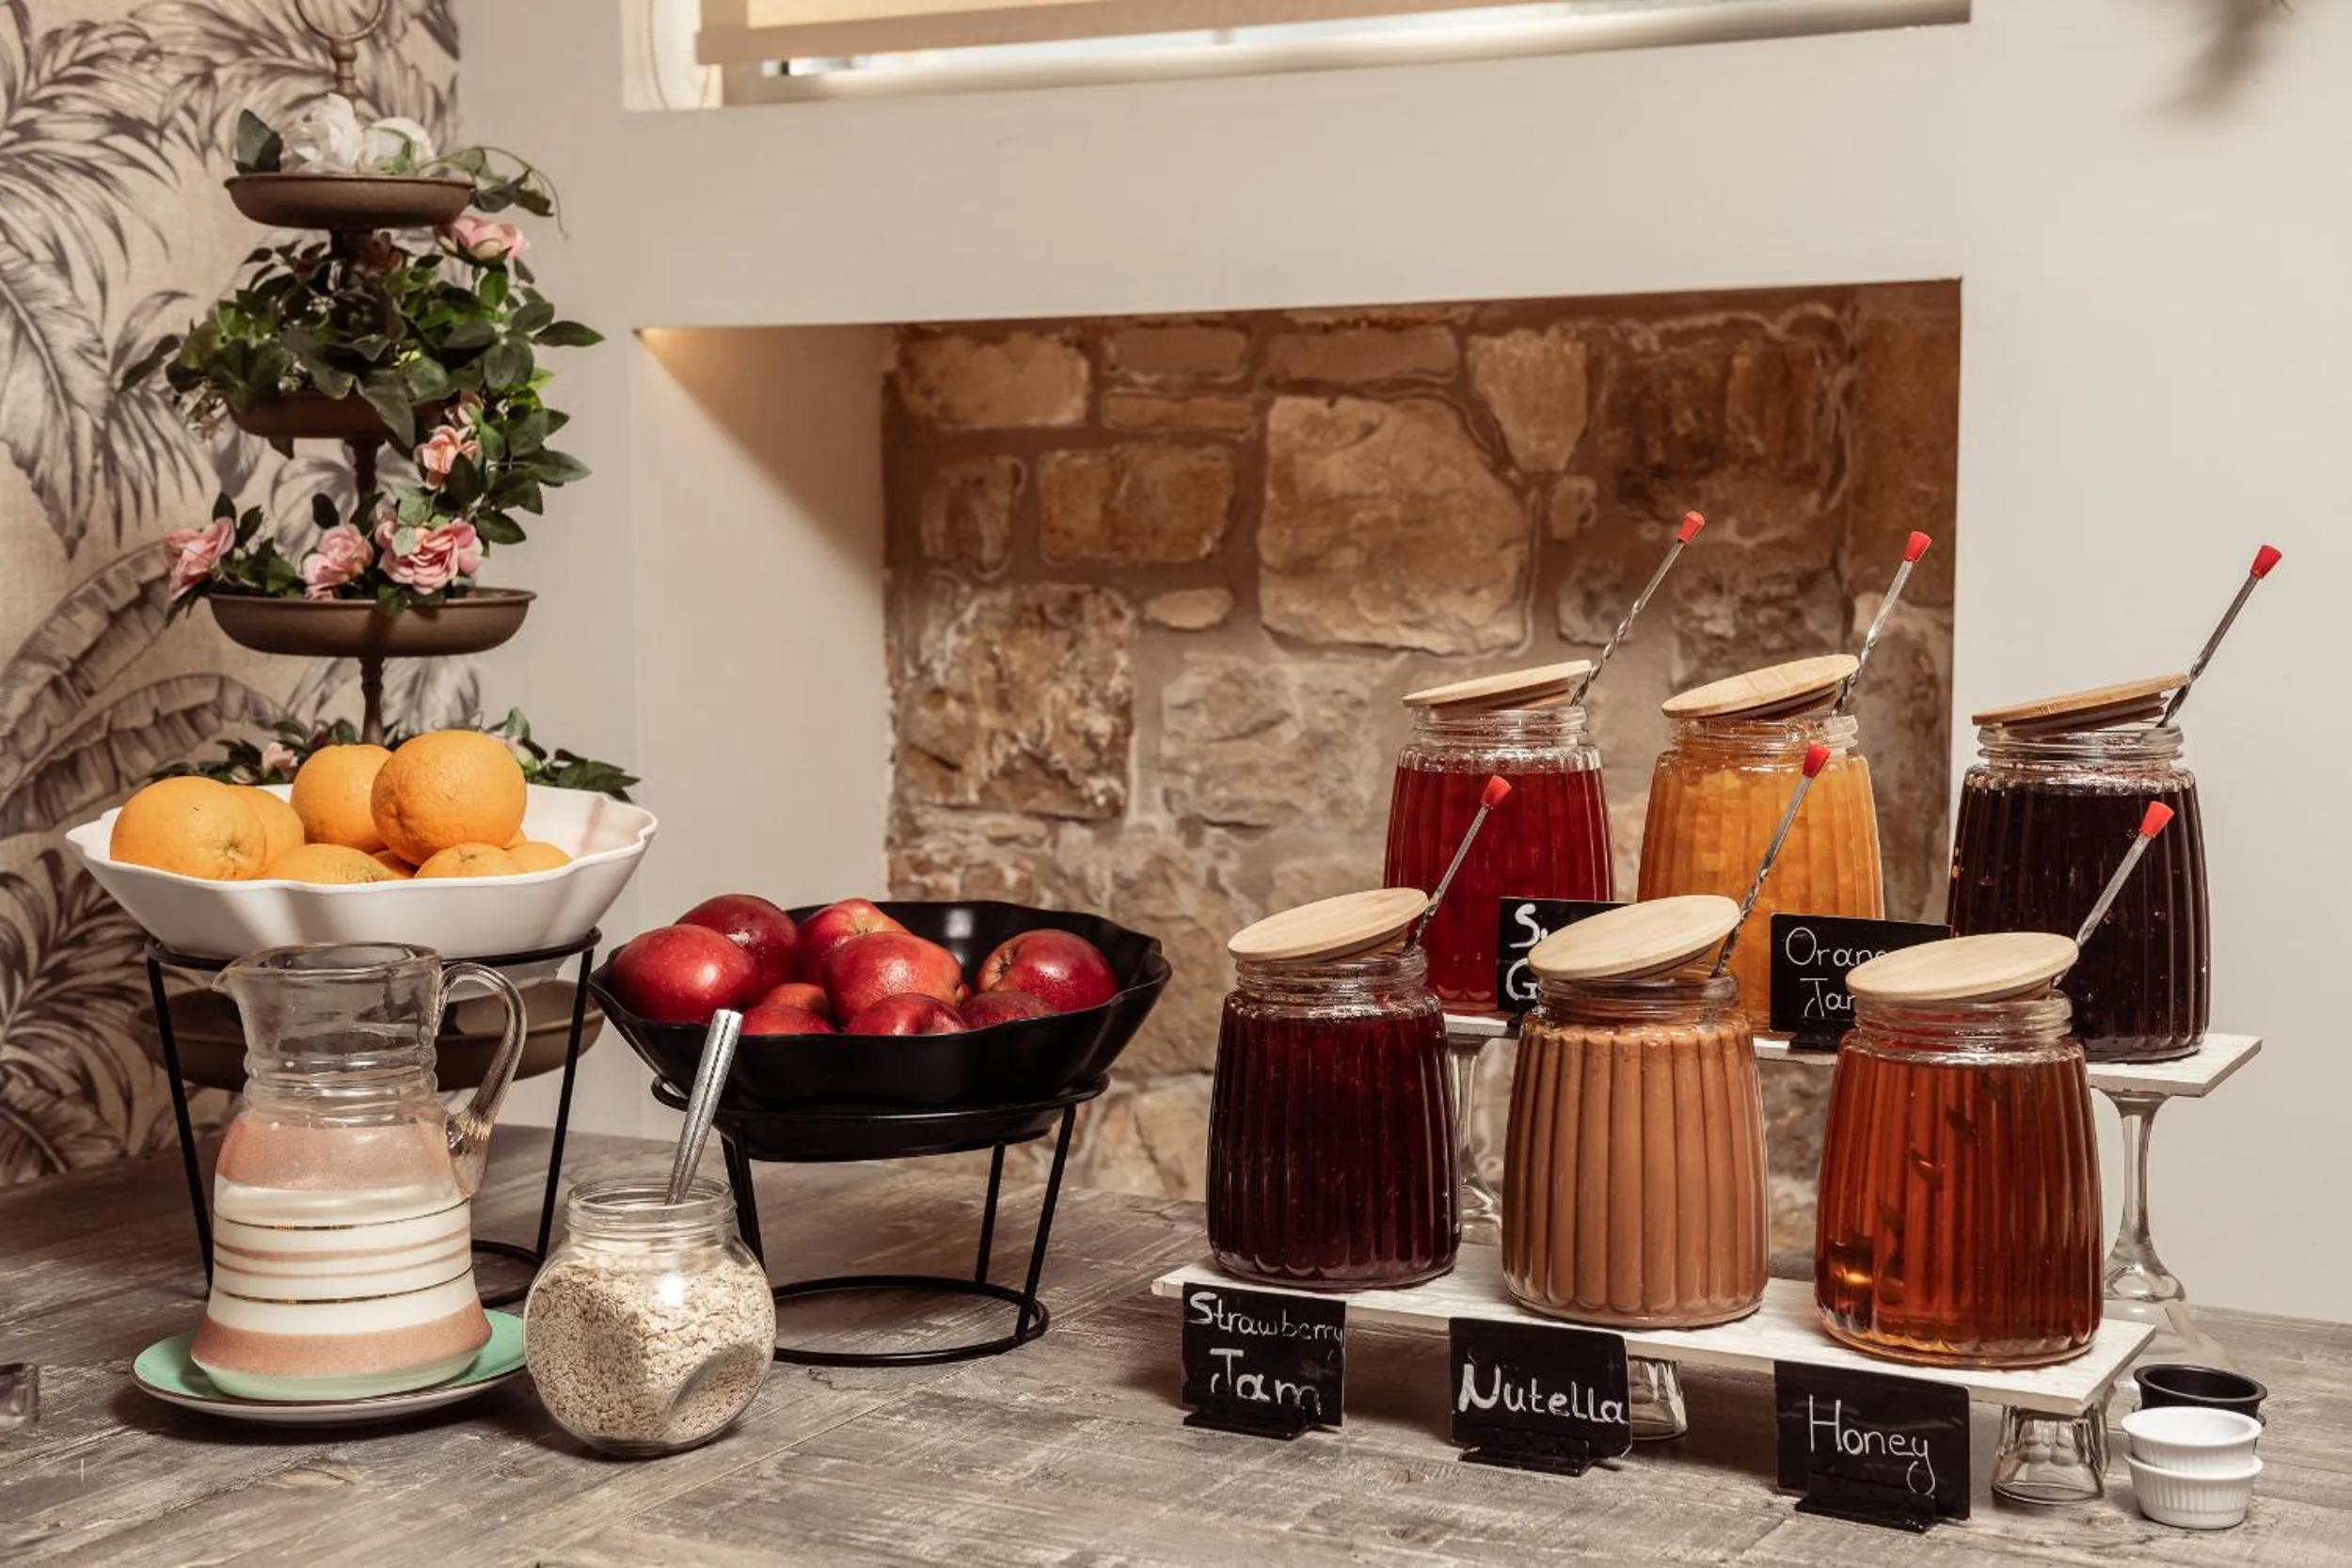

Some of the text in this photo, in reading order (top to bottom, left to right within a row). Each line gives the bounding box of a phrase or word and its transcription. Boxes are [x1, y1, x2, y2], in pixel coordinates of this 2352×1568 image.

[1187, 1291, 1343, 1361] Strawberry
[1209, 1347, 1322, 1416] Jam
[1458, 1363, 1629, 1425] Nutella
[1808, 1394, 1936, 1498] Honey
